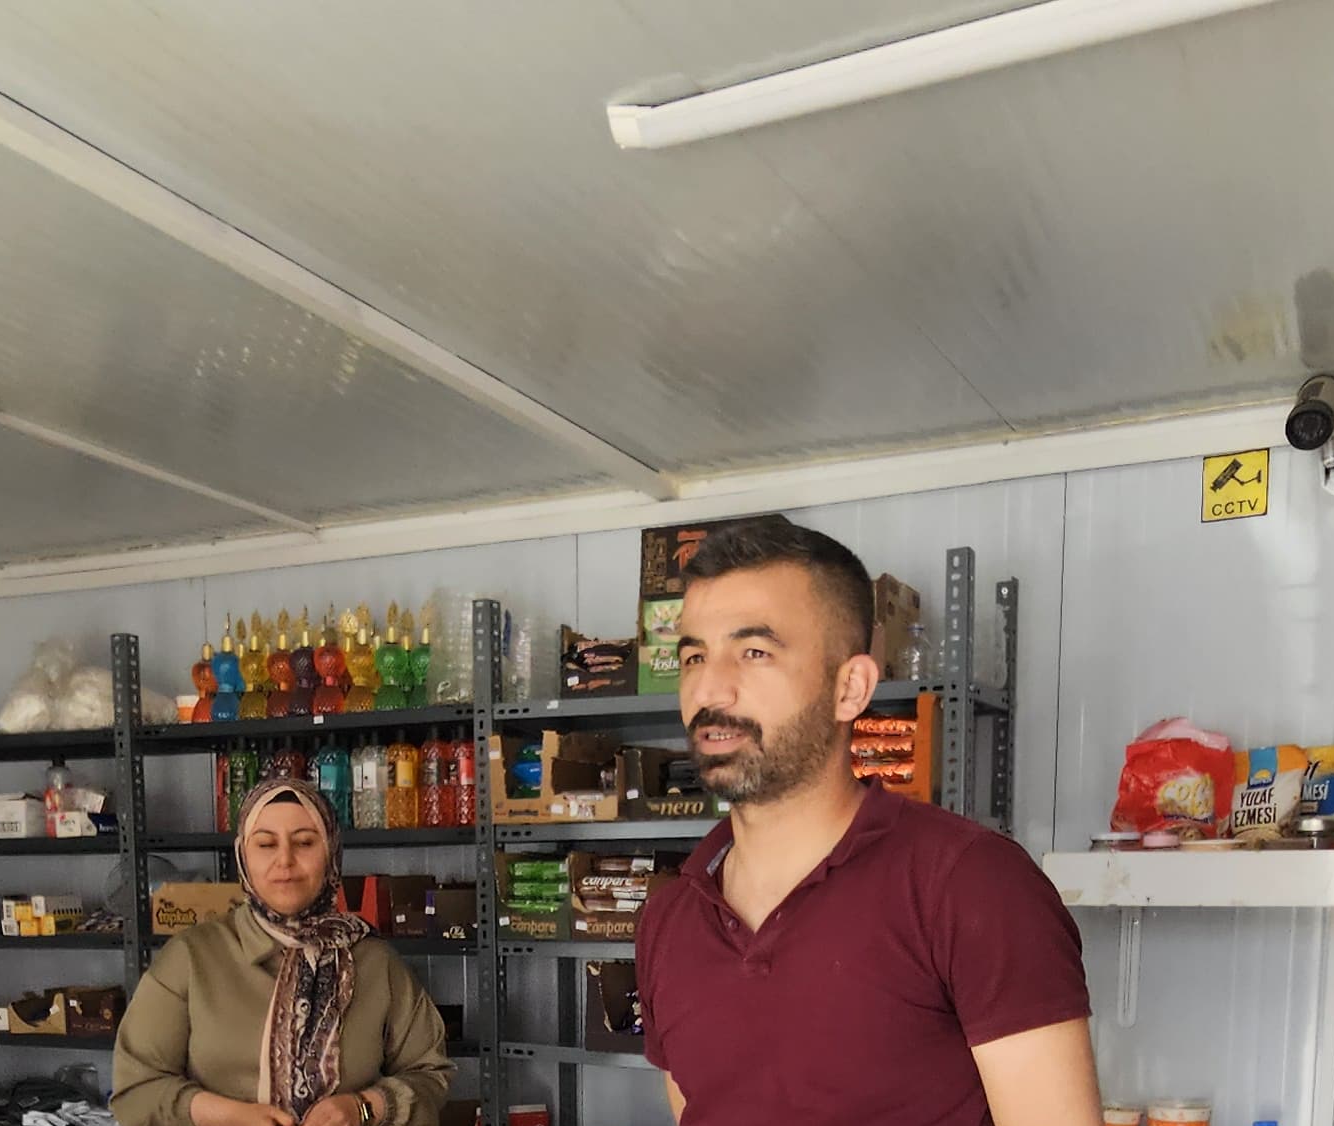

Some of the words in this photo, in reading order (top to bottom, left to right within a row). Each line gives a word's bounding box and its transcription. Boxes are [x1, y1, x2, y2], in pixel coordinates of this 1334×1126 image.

[1211, 498, 1259, 517] CCTV
[1239, 787, 1274, 808] YULAF
[1301, 781, 1329, 801] MESİ
[659, 801, 704, 815] nero
[1234, 804, 1277, 828] EZMESİ
